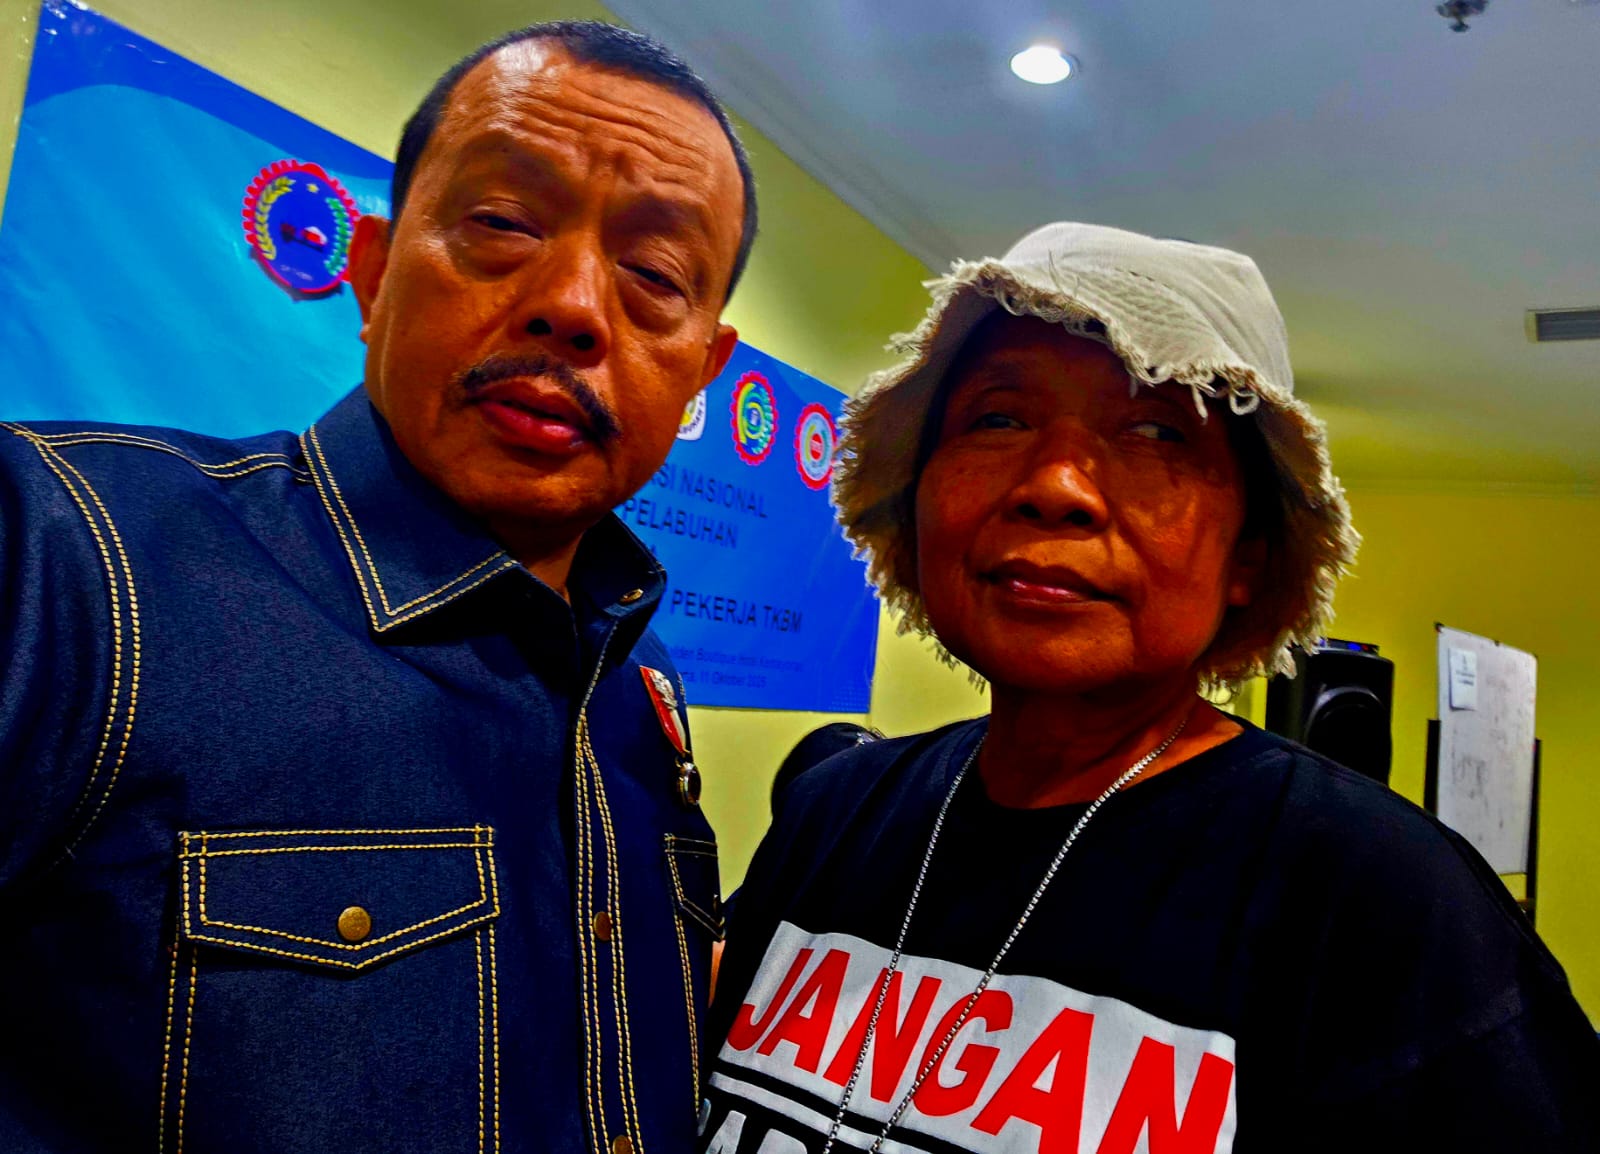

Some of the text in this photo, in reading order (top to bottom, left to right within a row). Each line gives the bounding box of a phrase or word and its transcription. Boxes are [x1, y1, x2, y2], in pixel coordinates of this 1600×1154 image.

[651, 463, 768, 520] SI NASIONAL
[621, 498, 738, 549] PELABUHAN
[671, 589, 803, 633] PEKERJA TKBM
[727, 948, 1235, 1154] JANGAN
